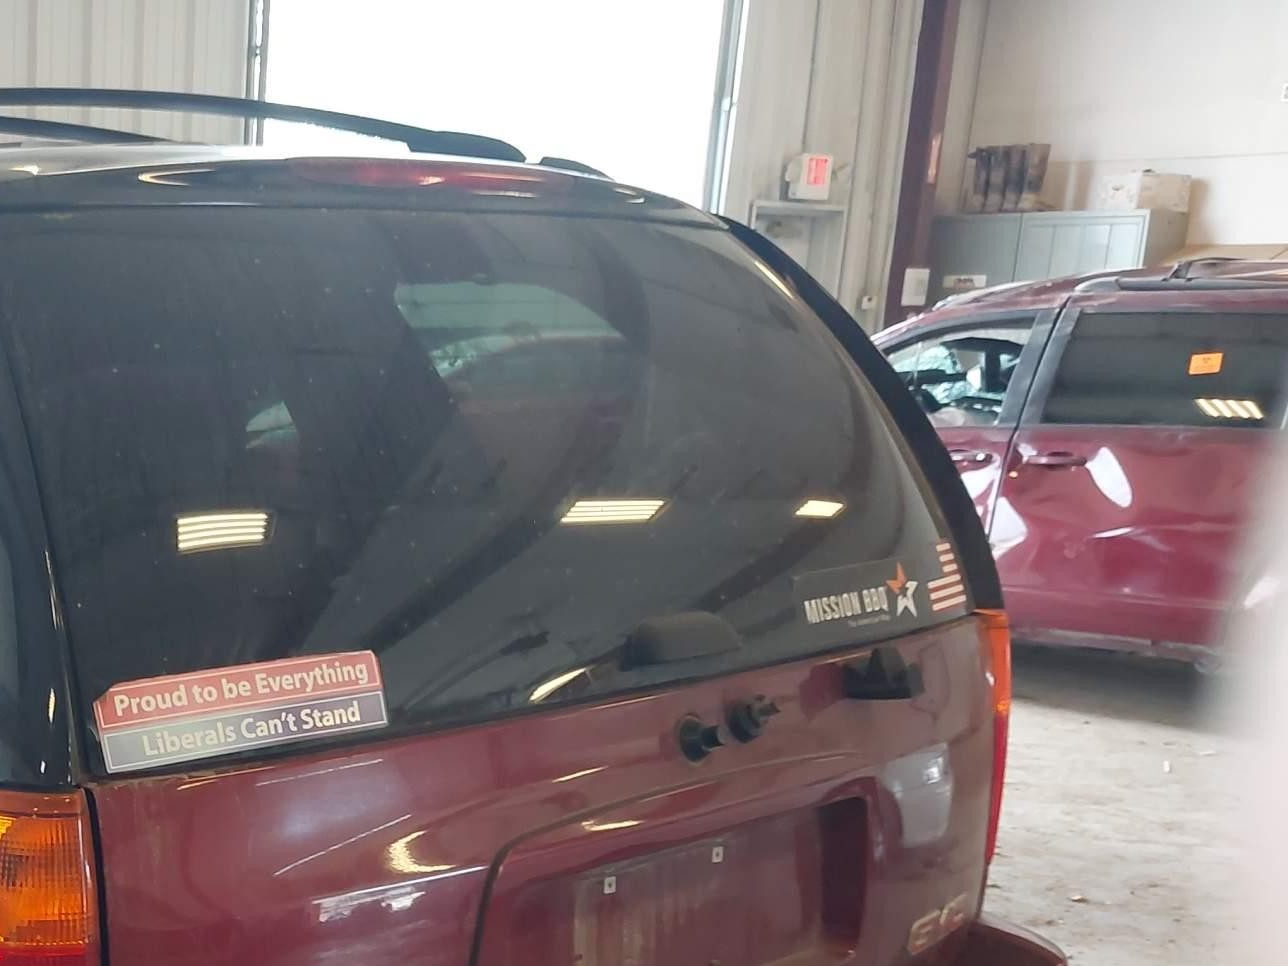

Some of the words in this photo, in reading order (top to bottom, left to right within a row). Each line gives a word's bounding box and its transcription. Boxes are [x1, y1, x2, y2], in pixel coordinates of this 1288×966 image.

[804, 591, 862, 624] MISSION
[862, 586, 890, 614] BBQ
[113, 684, 188, 717] Proud
[192, 684, 218, 704] to
[222, 677, 252, 699] be
[255, 660, 369, 695] Everything
[142, 721, 237, 757] Liberals
[240, 710, 298, 738] Can't
[301, 700, 361, 729] Stand
